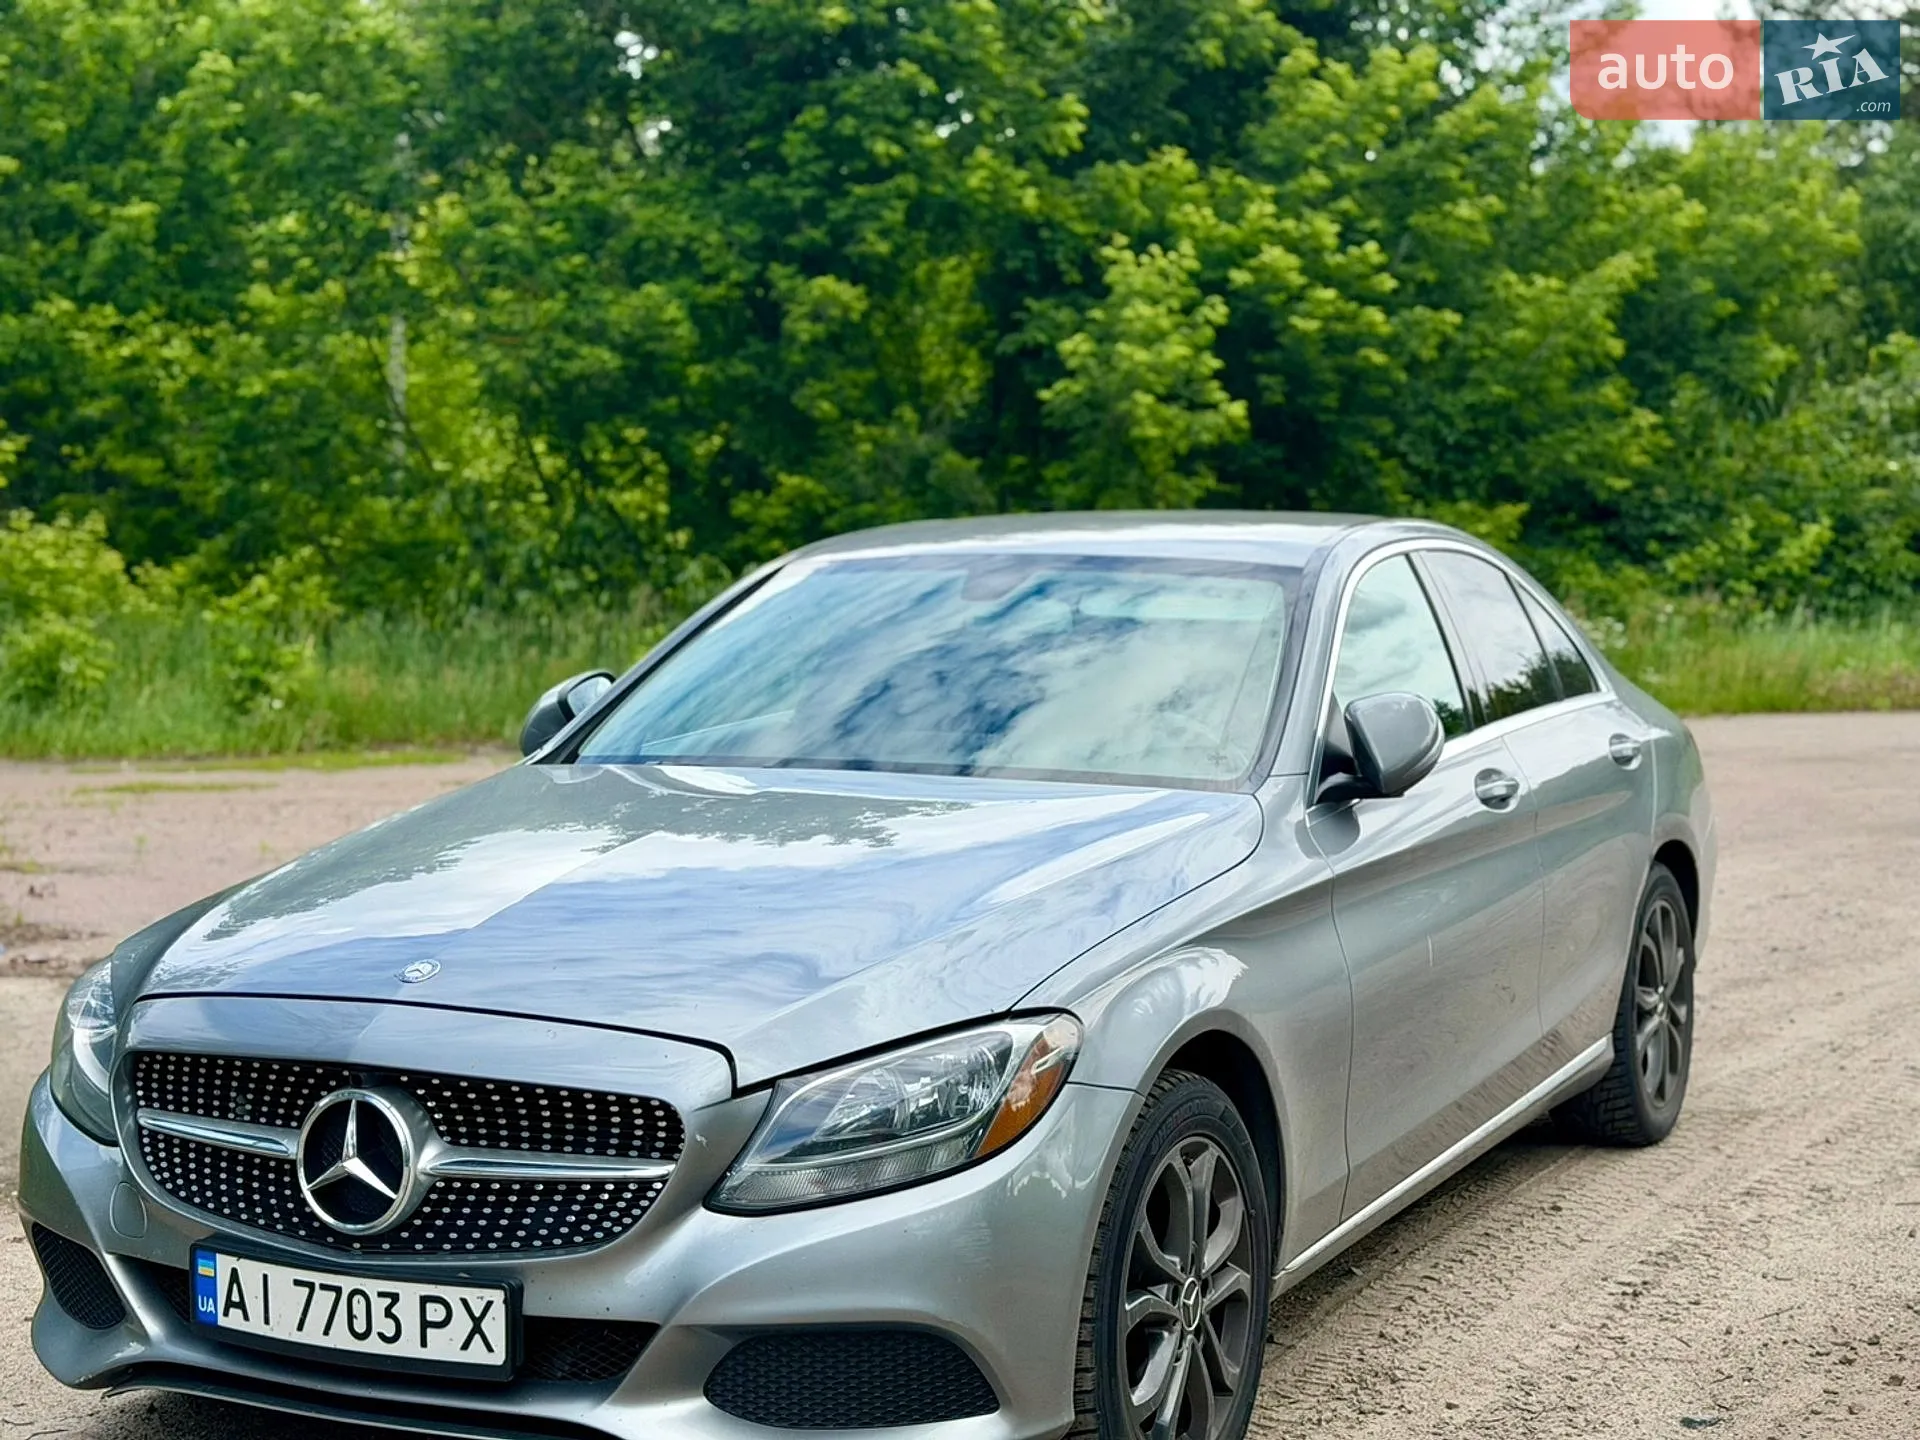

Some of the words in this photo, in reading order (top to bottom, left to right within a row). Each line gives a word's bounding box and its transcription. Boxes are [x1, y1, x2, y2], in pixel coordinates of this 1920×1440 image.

[197, 1294, 216, 1314] UA
[222, 1267, 271, 1326] AI
[292, 1278, 403, 1344] 7703
[418, 1294, 495, 1353] PX
